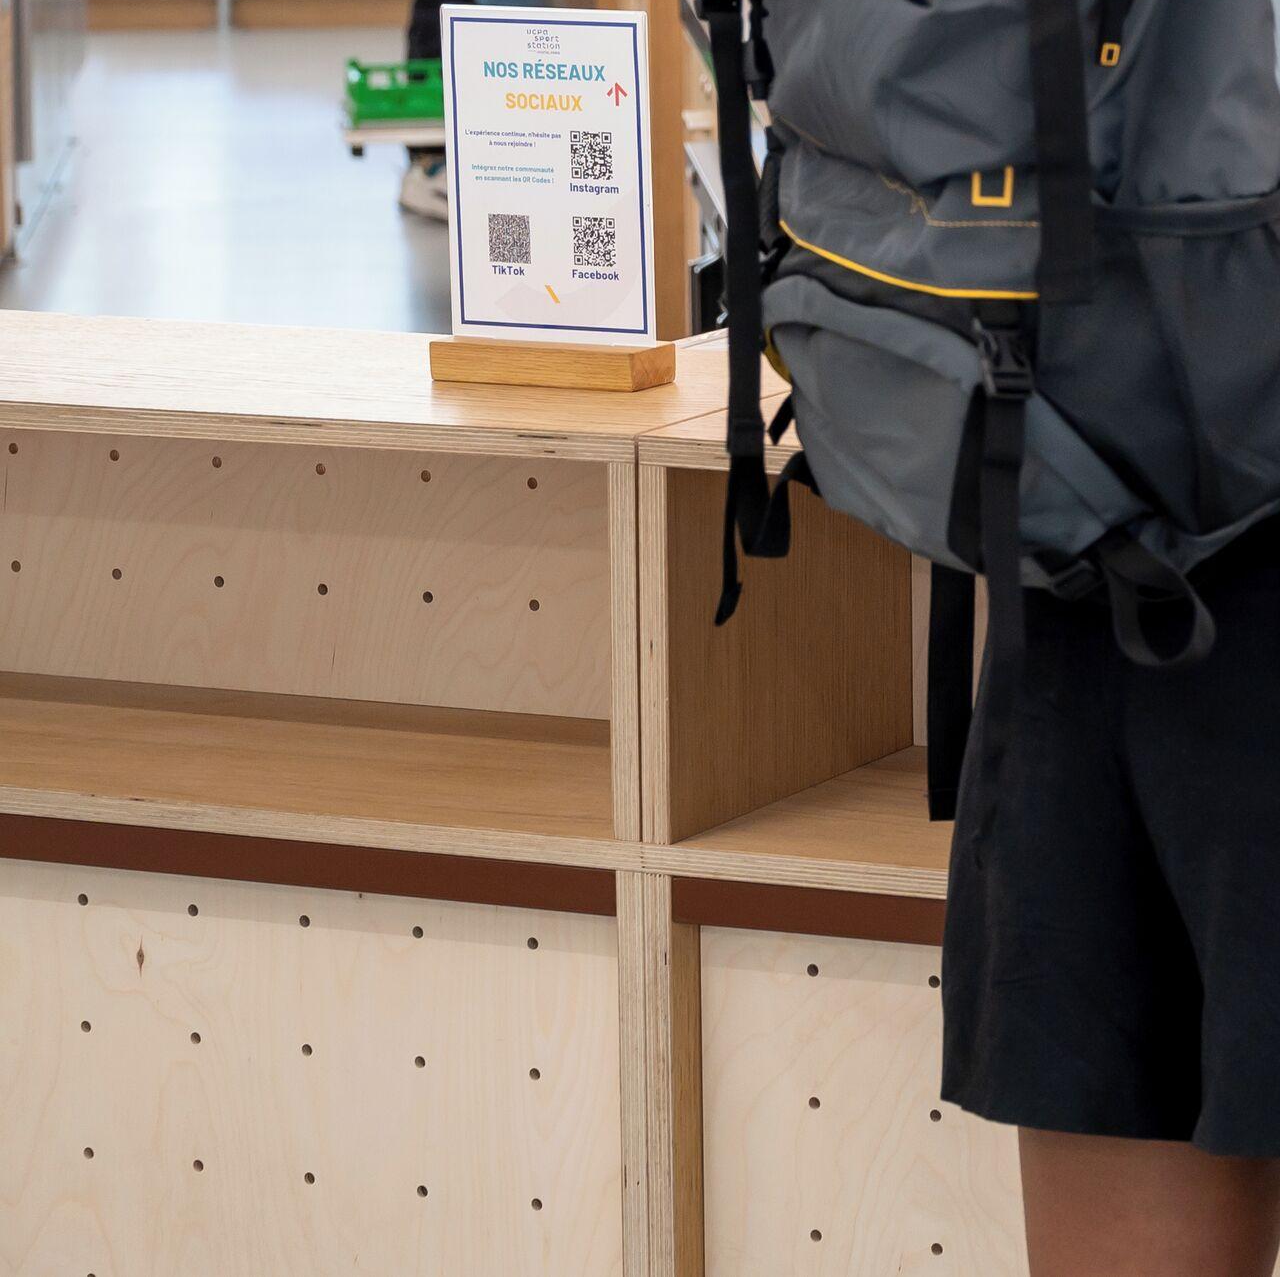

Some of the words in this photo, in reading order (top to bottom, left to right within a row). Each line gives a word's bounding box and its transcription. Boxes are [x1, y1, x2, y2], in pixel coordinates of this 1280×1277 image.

[527, 42, 560, 50] station
[483, 61, 518, 78] NOS
[522, 59, 606, 82] RÉSEAUX
[505, 92, 583, 112] SOCIAUX
[464, 129, 500, 137] L'expérience
[508, 140, 533, 148] rejoindre
[471, 163, 497, 172] Intégrez
[569, 182, 620, 195] Instagram
[492, 264, 525, 276] TikTok
[572, 269, 620, 281] Facebook
